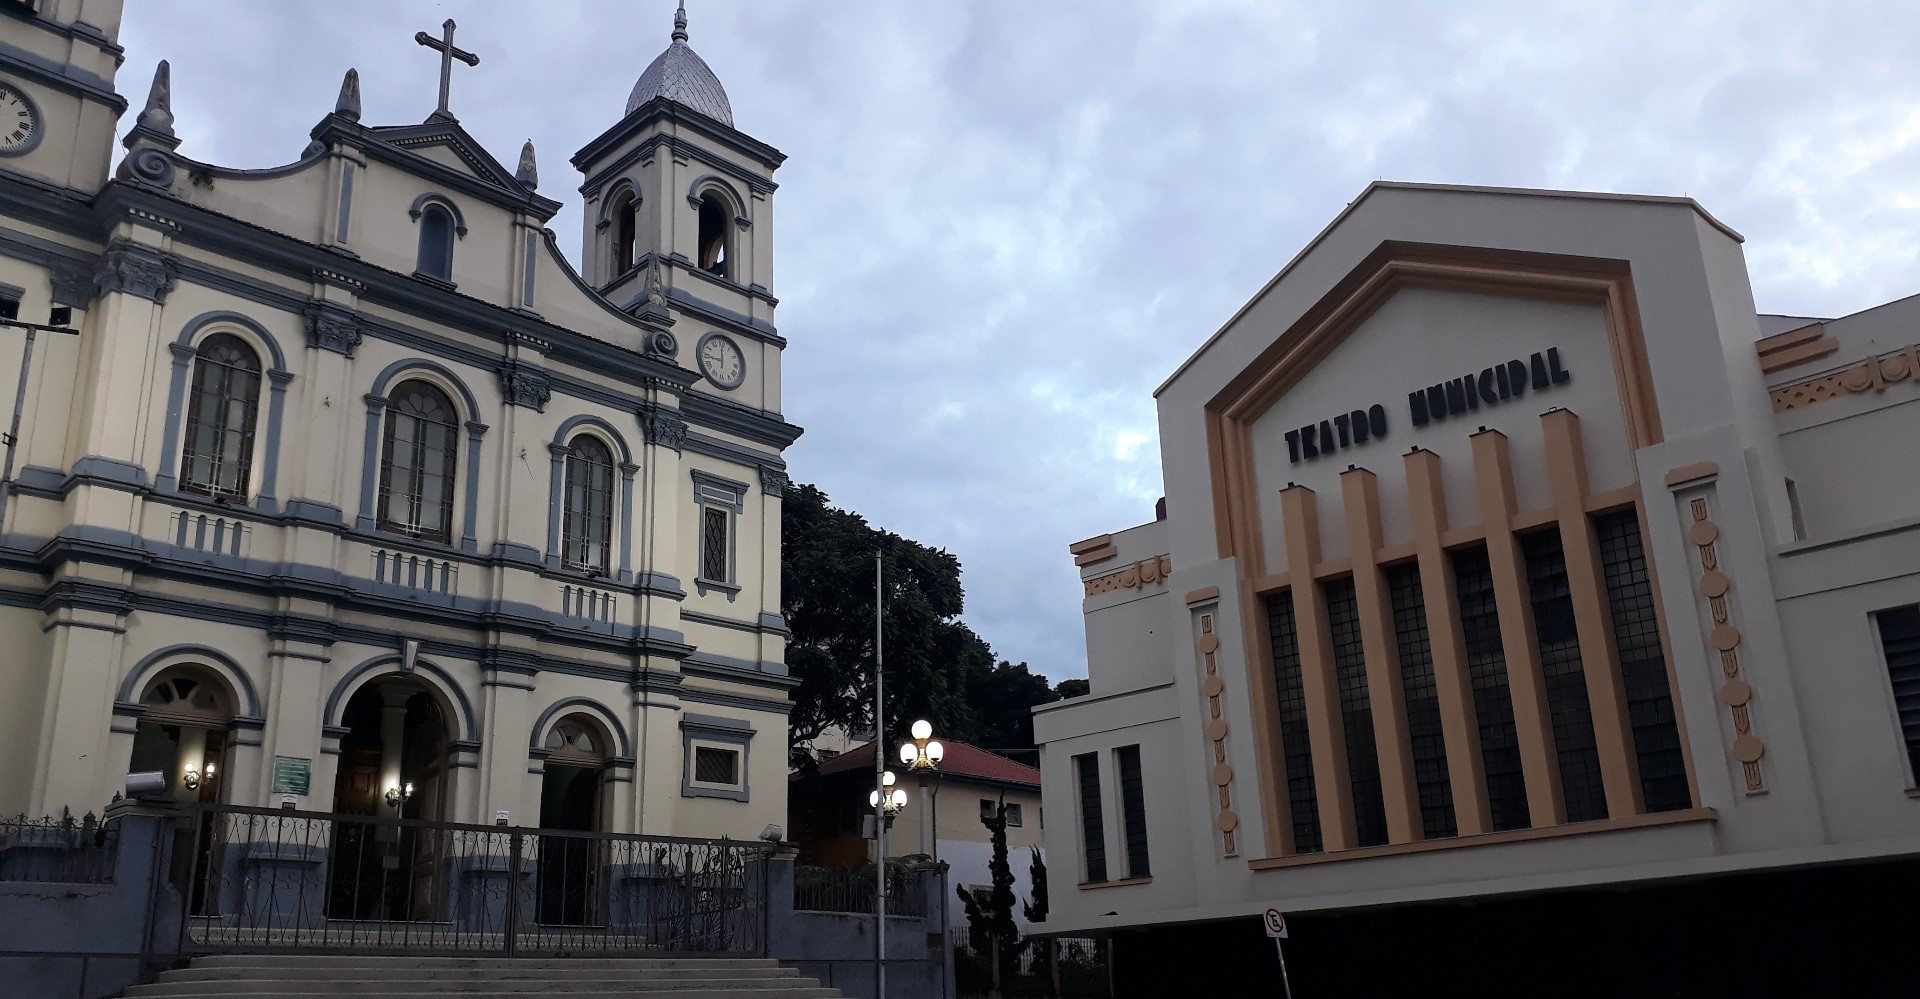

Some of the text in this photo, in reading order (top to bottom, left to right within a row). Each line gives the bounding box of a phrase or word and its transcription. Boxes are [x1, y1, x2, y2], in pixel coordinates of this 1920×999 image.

[18, 121, 30, 131] III
[1284, 346, 1570, 464] TEATRO MUNICIPAL
[1269, 914, 1280, 928] E
